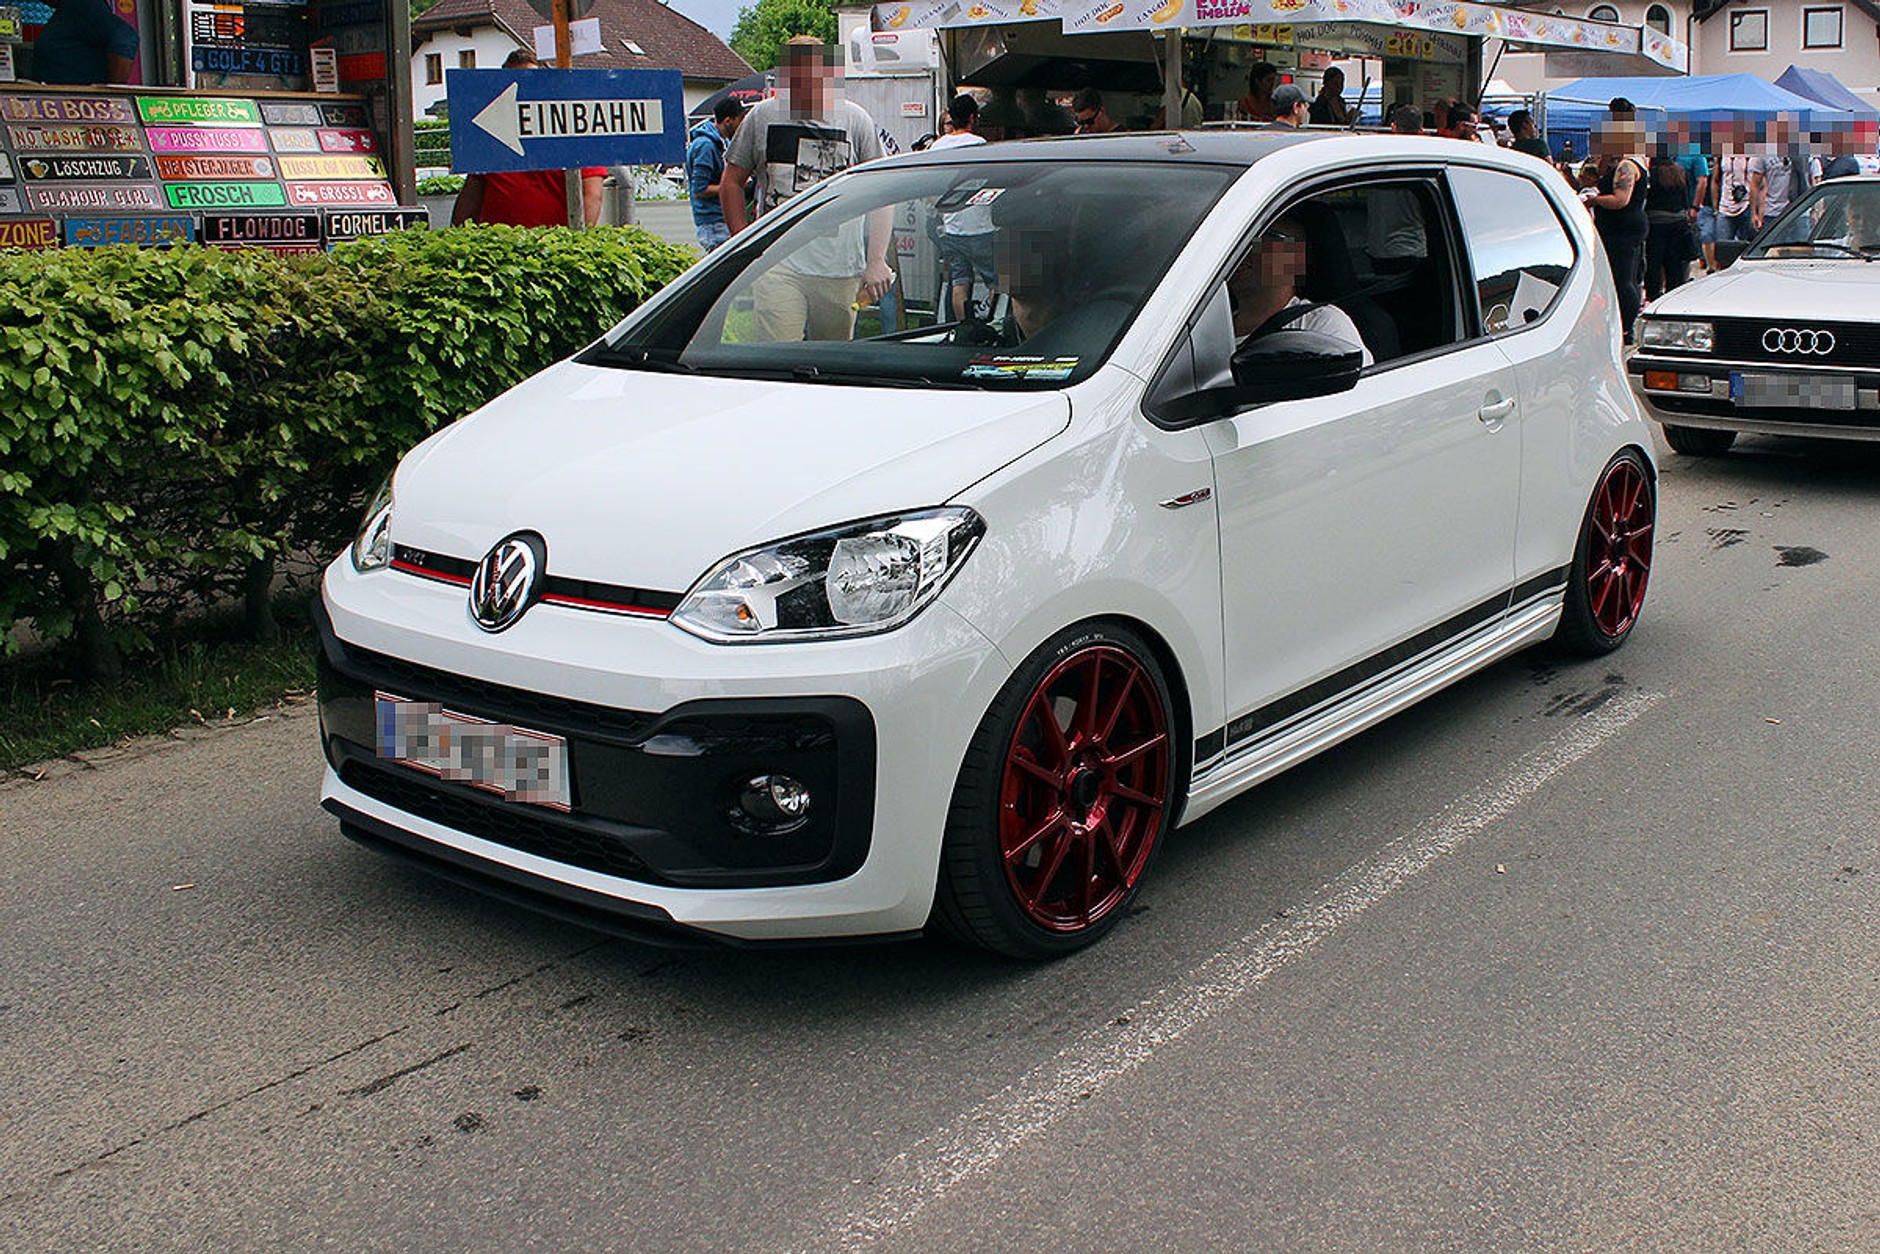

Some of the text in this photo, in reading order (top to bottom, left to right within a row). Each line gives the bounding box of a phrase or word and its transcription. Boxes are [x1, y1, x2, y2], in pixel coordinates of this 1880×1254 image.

[208, 50, 251, 70] GOLF
[255, 51, 266, 72] 4
[270, 53, 302, 73] GTI
[9, 99, 125, 119] BIG BOSS
[172, 102, 227, 118] PFLEGER
[518, 101, 647, 136] EINBAHN
[15, 130, 136, 147] NO CASH NO SEX
[170, 133, 245, 148] PUSSYTUSSI
[53, 160, 122, 176] LÖSCHZUG
[284, 159, 320, 176] TUSSI
[38, 189, 153, 207] GLAMOUR GIRL
[175, 186, 254, 205] FROSCH
[104, 220, 188, 243] FABIAN
[217, 217, 307, 239] FLOWDOG
[331, 213, 405, 235] FORMEL 1
[0, 222, 51, 246] ZONE
